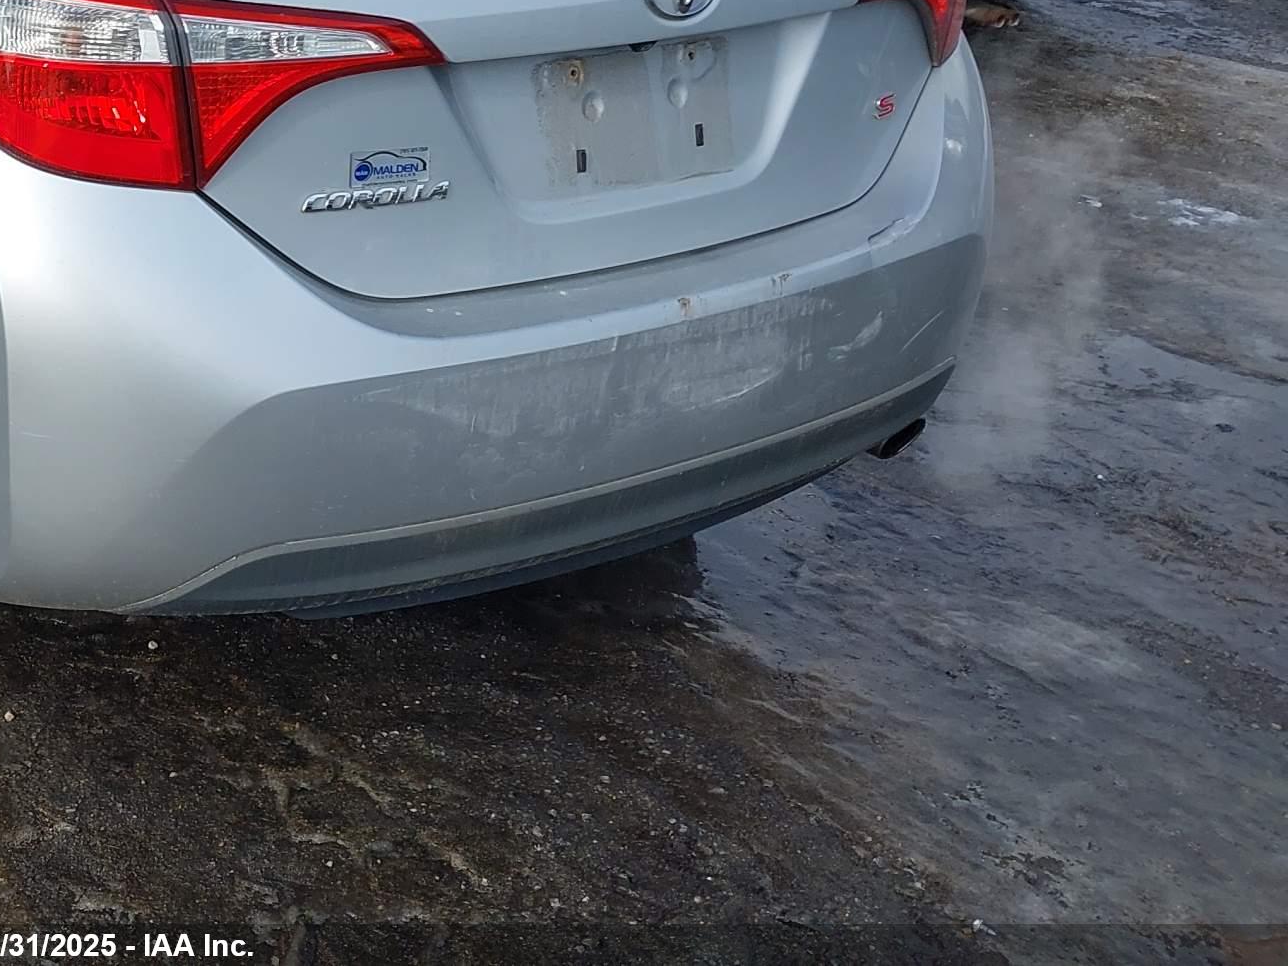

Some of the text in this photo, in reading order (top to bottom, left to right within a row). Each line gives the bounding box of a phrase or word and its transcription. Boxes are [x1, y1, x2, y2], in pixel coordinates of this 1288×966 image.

[874, 93, 896, 119] S
[373, 163, 419, 176] MALDEN
[301, 181, 450, 213] COROLLA
